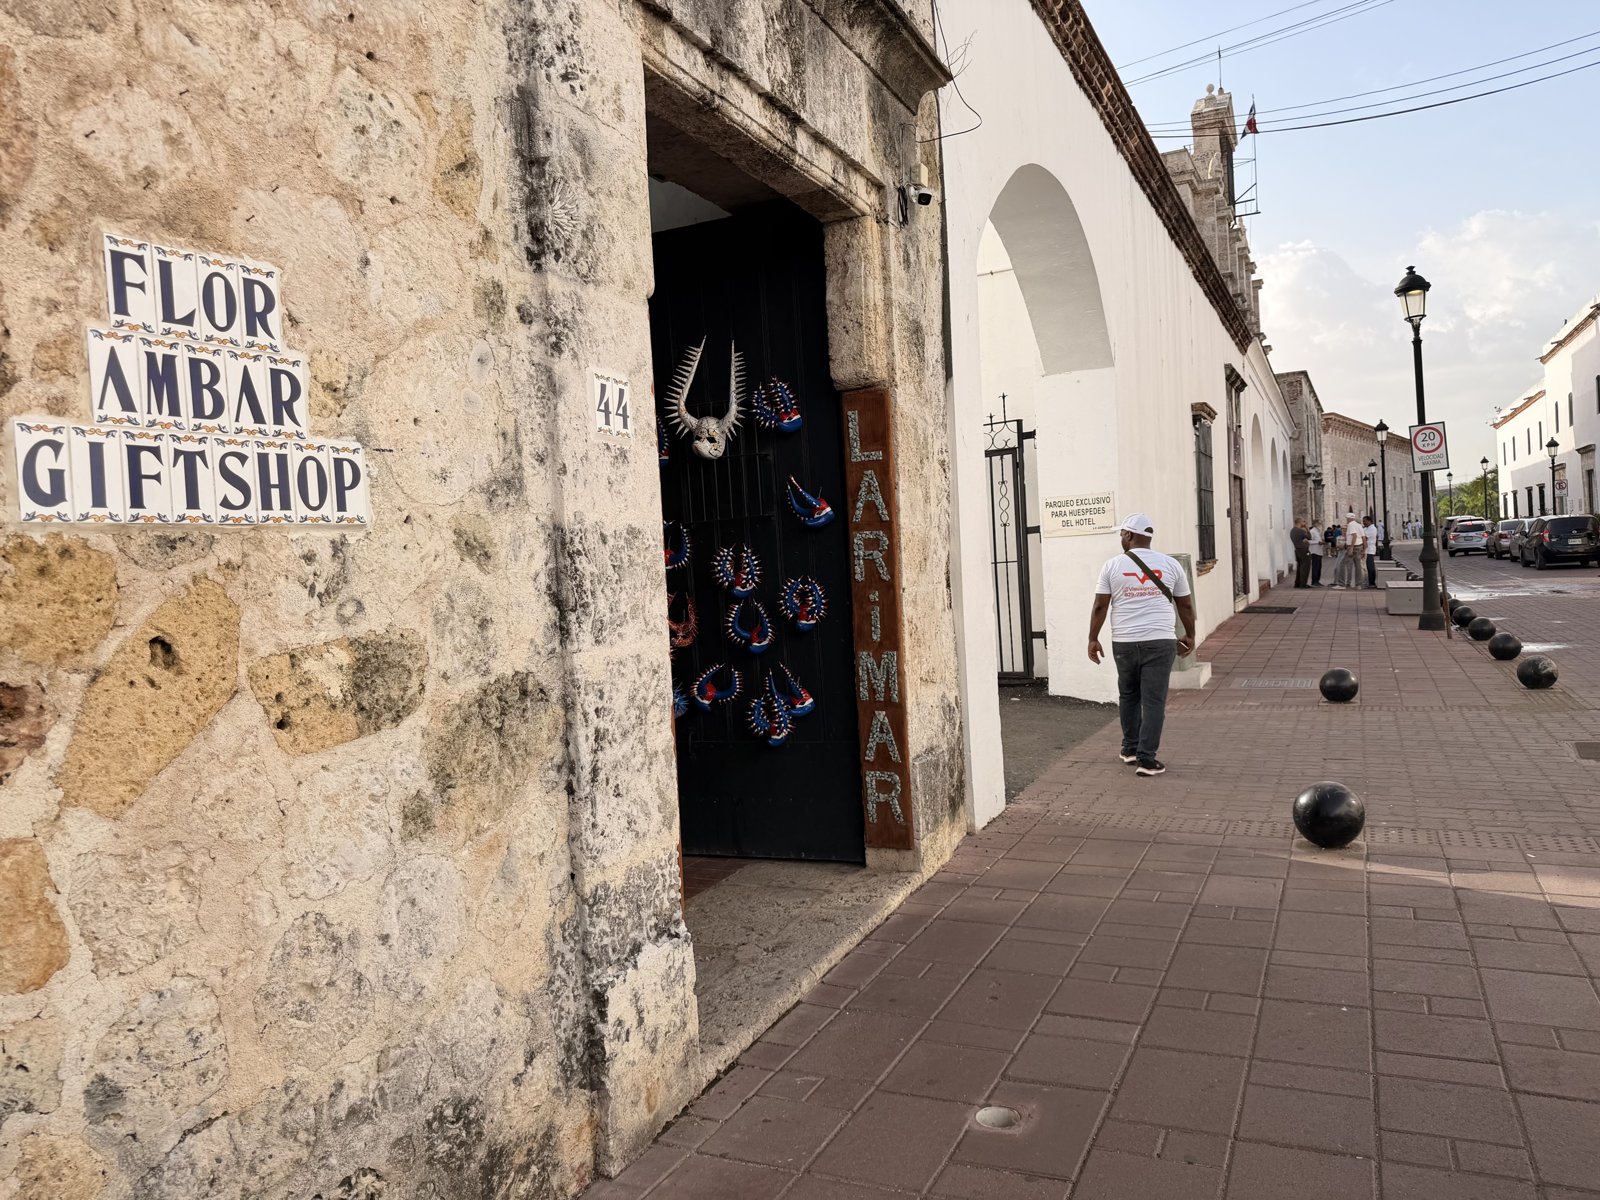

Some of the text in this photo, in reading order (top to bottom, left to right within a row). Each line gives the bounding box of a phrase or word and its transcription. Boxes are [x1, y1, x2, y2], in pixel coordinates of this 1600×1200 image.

[109, 249, 277, 340] FLOR
[97, 345, 302, 427] AMBAR
[597, 383, 629, 429] 44
[1420, 431, 1436, 442] 20
[1418, 453, 1444, 461] VELOCIDAD
[22, 439, 361, 512] GIFTSHOP
[1045, 496, 1111, 509] PARQUEO EXCLUSIVO
[1051, 507, 1106, 518] PARA HUESPEDES
[1061, 517, 1096, 528] DEL HOTEL
